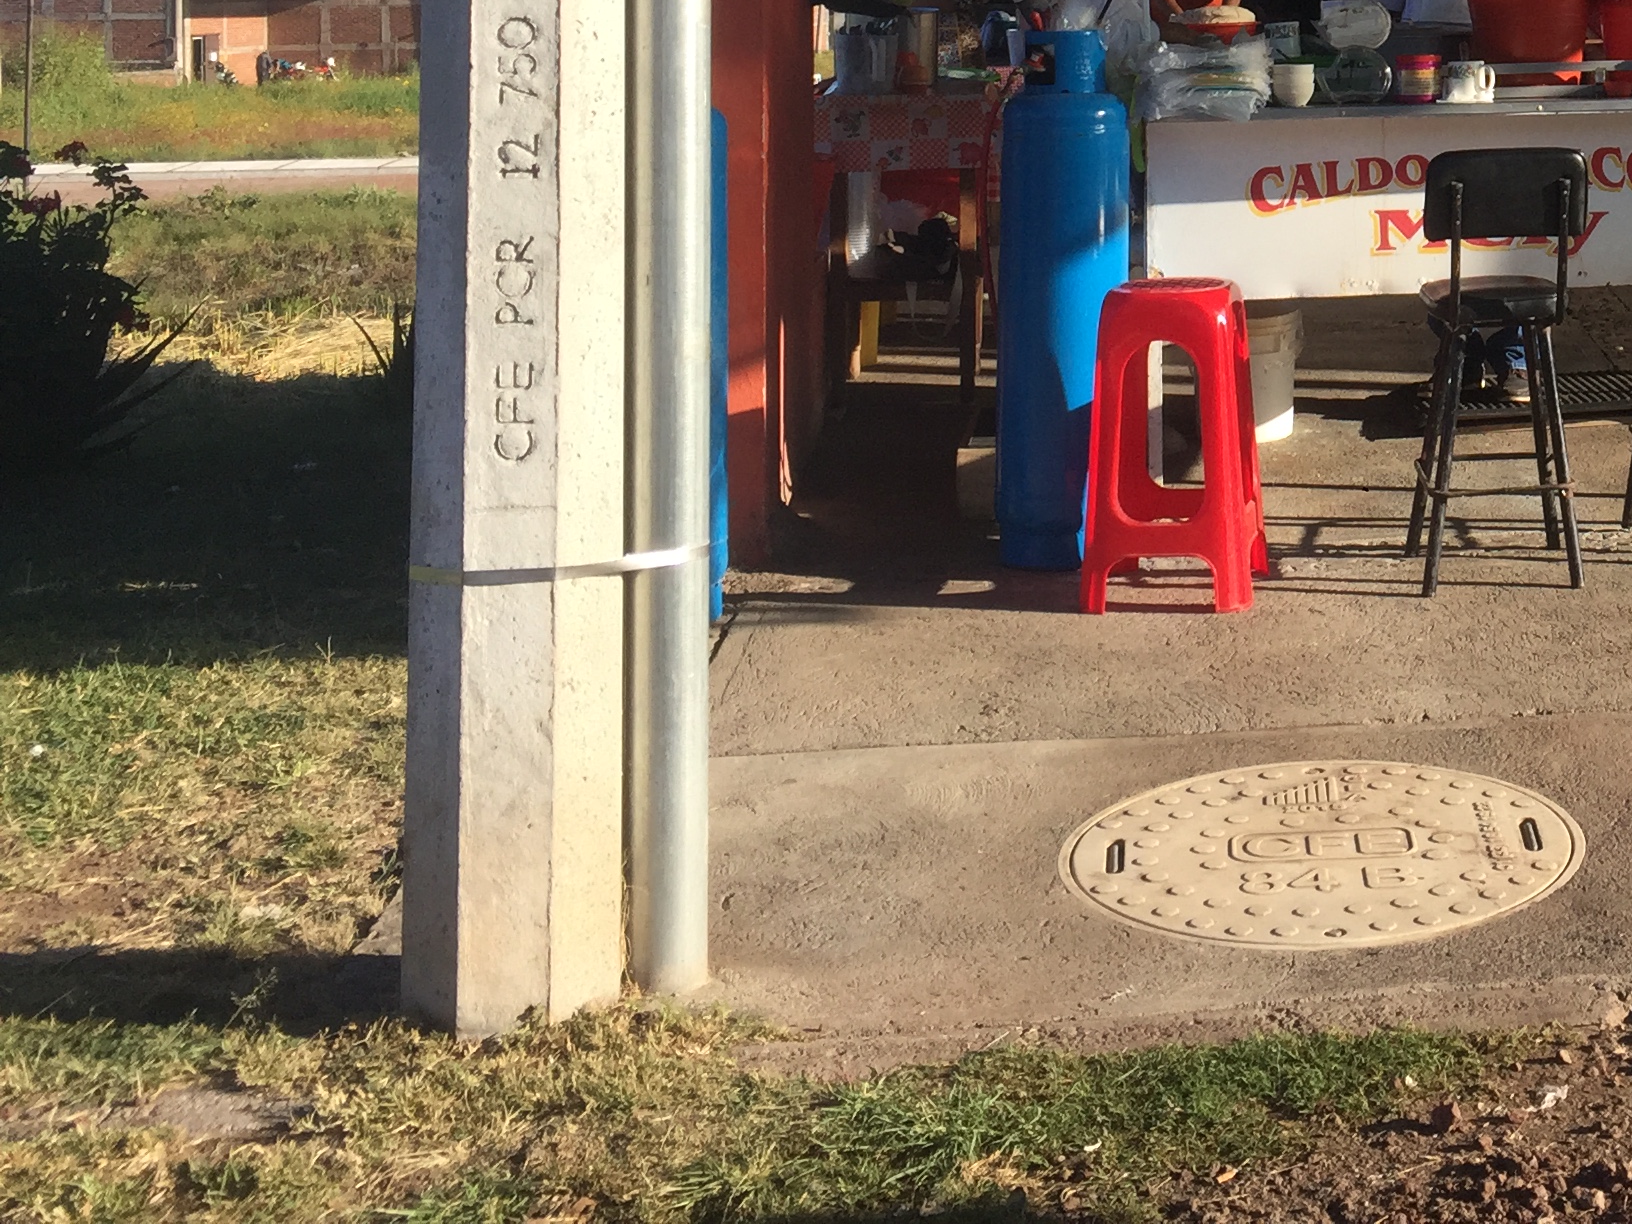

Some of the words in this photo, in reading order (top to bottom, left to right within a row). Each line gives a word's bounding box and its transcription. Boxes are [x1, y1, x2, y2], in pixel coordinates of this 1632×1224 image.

[1247, 154, 1427, 217] CALDO
[1370, 209, 1609, 258] My
[494, 235, 534, 325] PCR
[494, 360, 534, 462] CFE
[1242, 832, 1403, 860] CFE
[1238, 867, 1343, 896] 84
